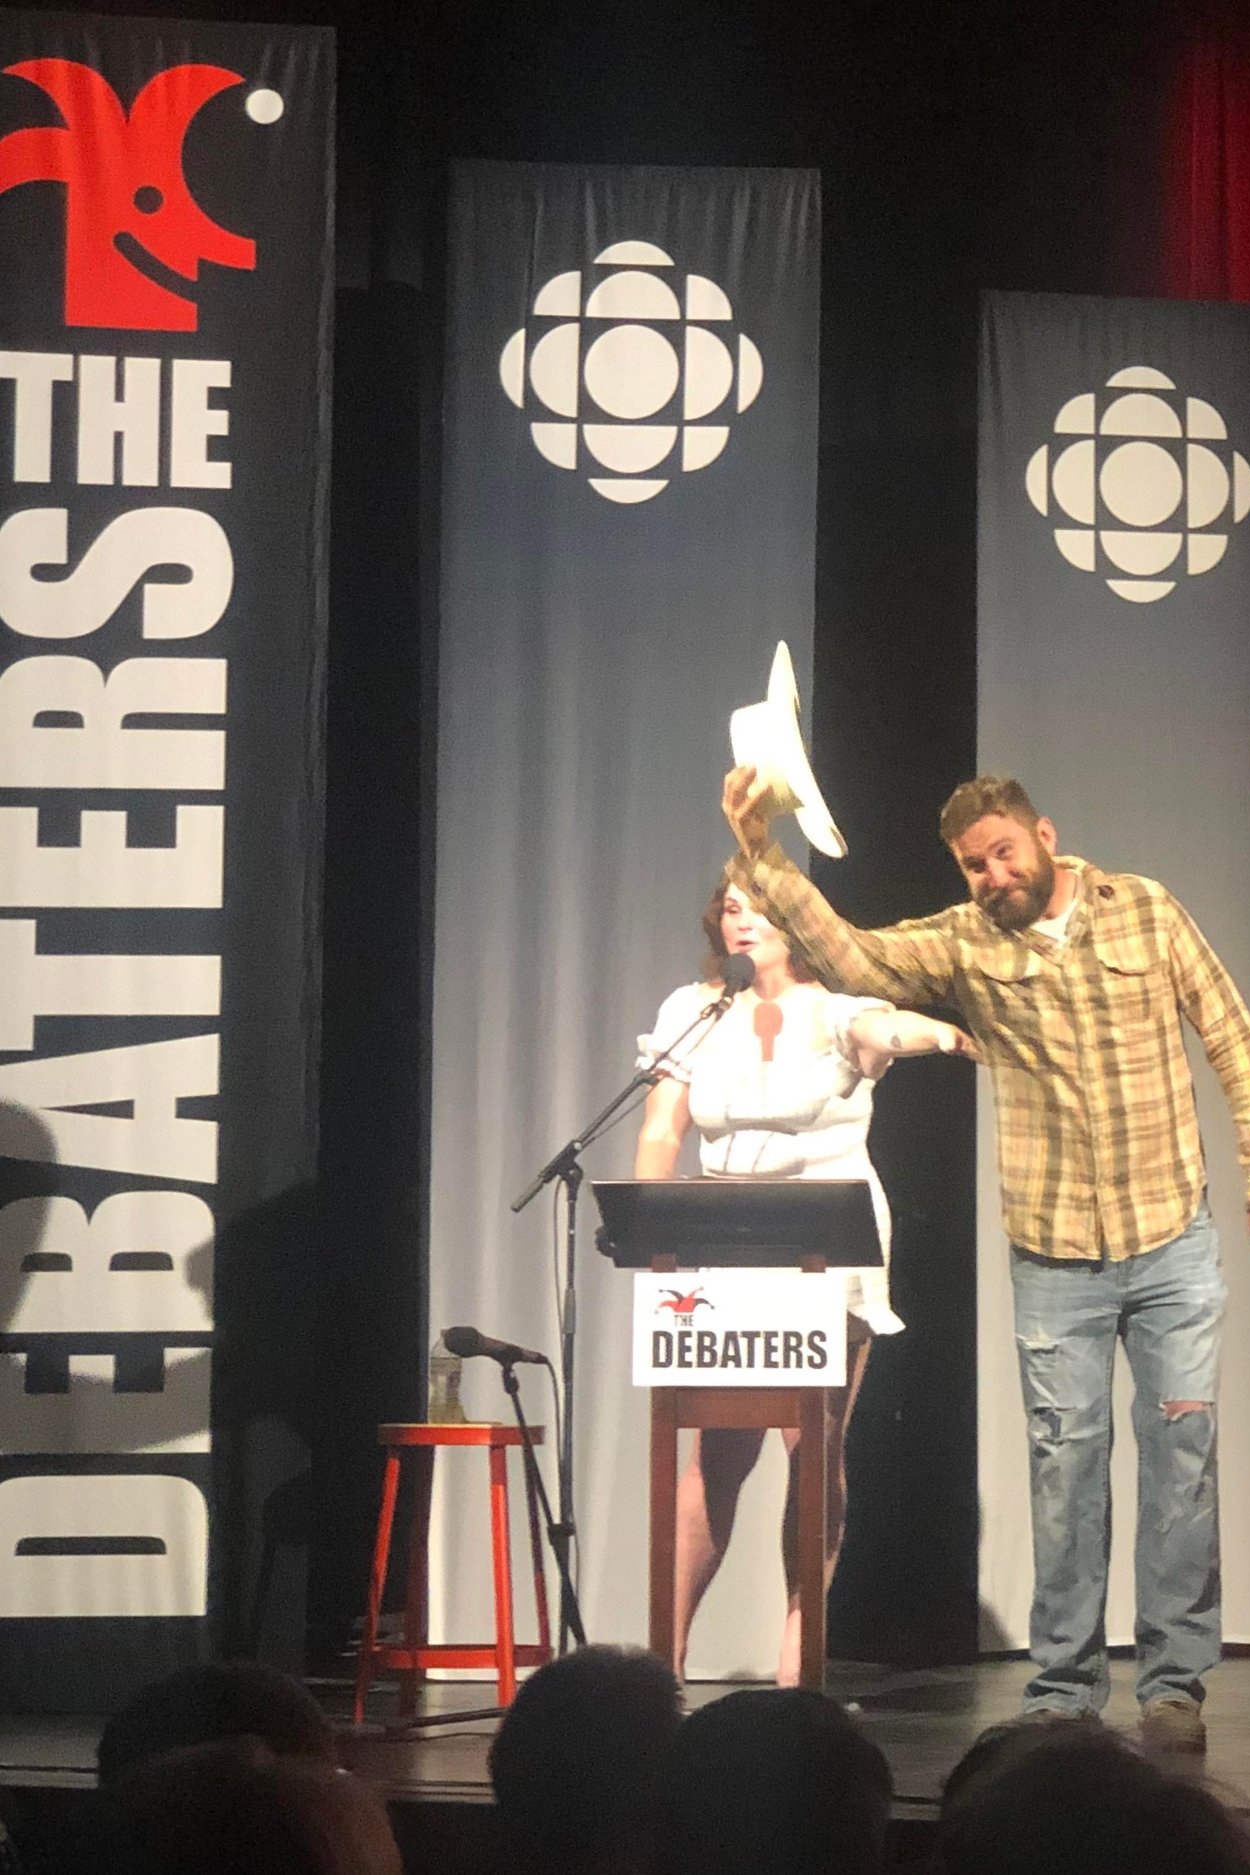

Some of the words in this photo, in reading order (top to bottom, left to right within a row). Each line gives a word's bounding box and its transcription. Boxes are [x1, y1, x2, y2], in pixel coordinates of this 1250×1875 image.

[0, 351, 233, 489] THE
[0, 507, 235, 1617] DEBATERS
[652, 1330, 829, 1370] DEBATERS
[674, 1314, 694, 1327] THE
